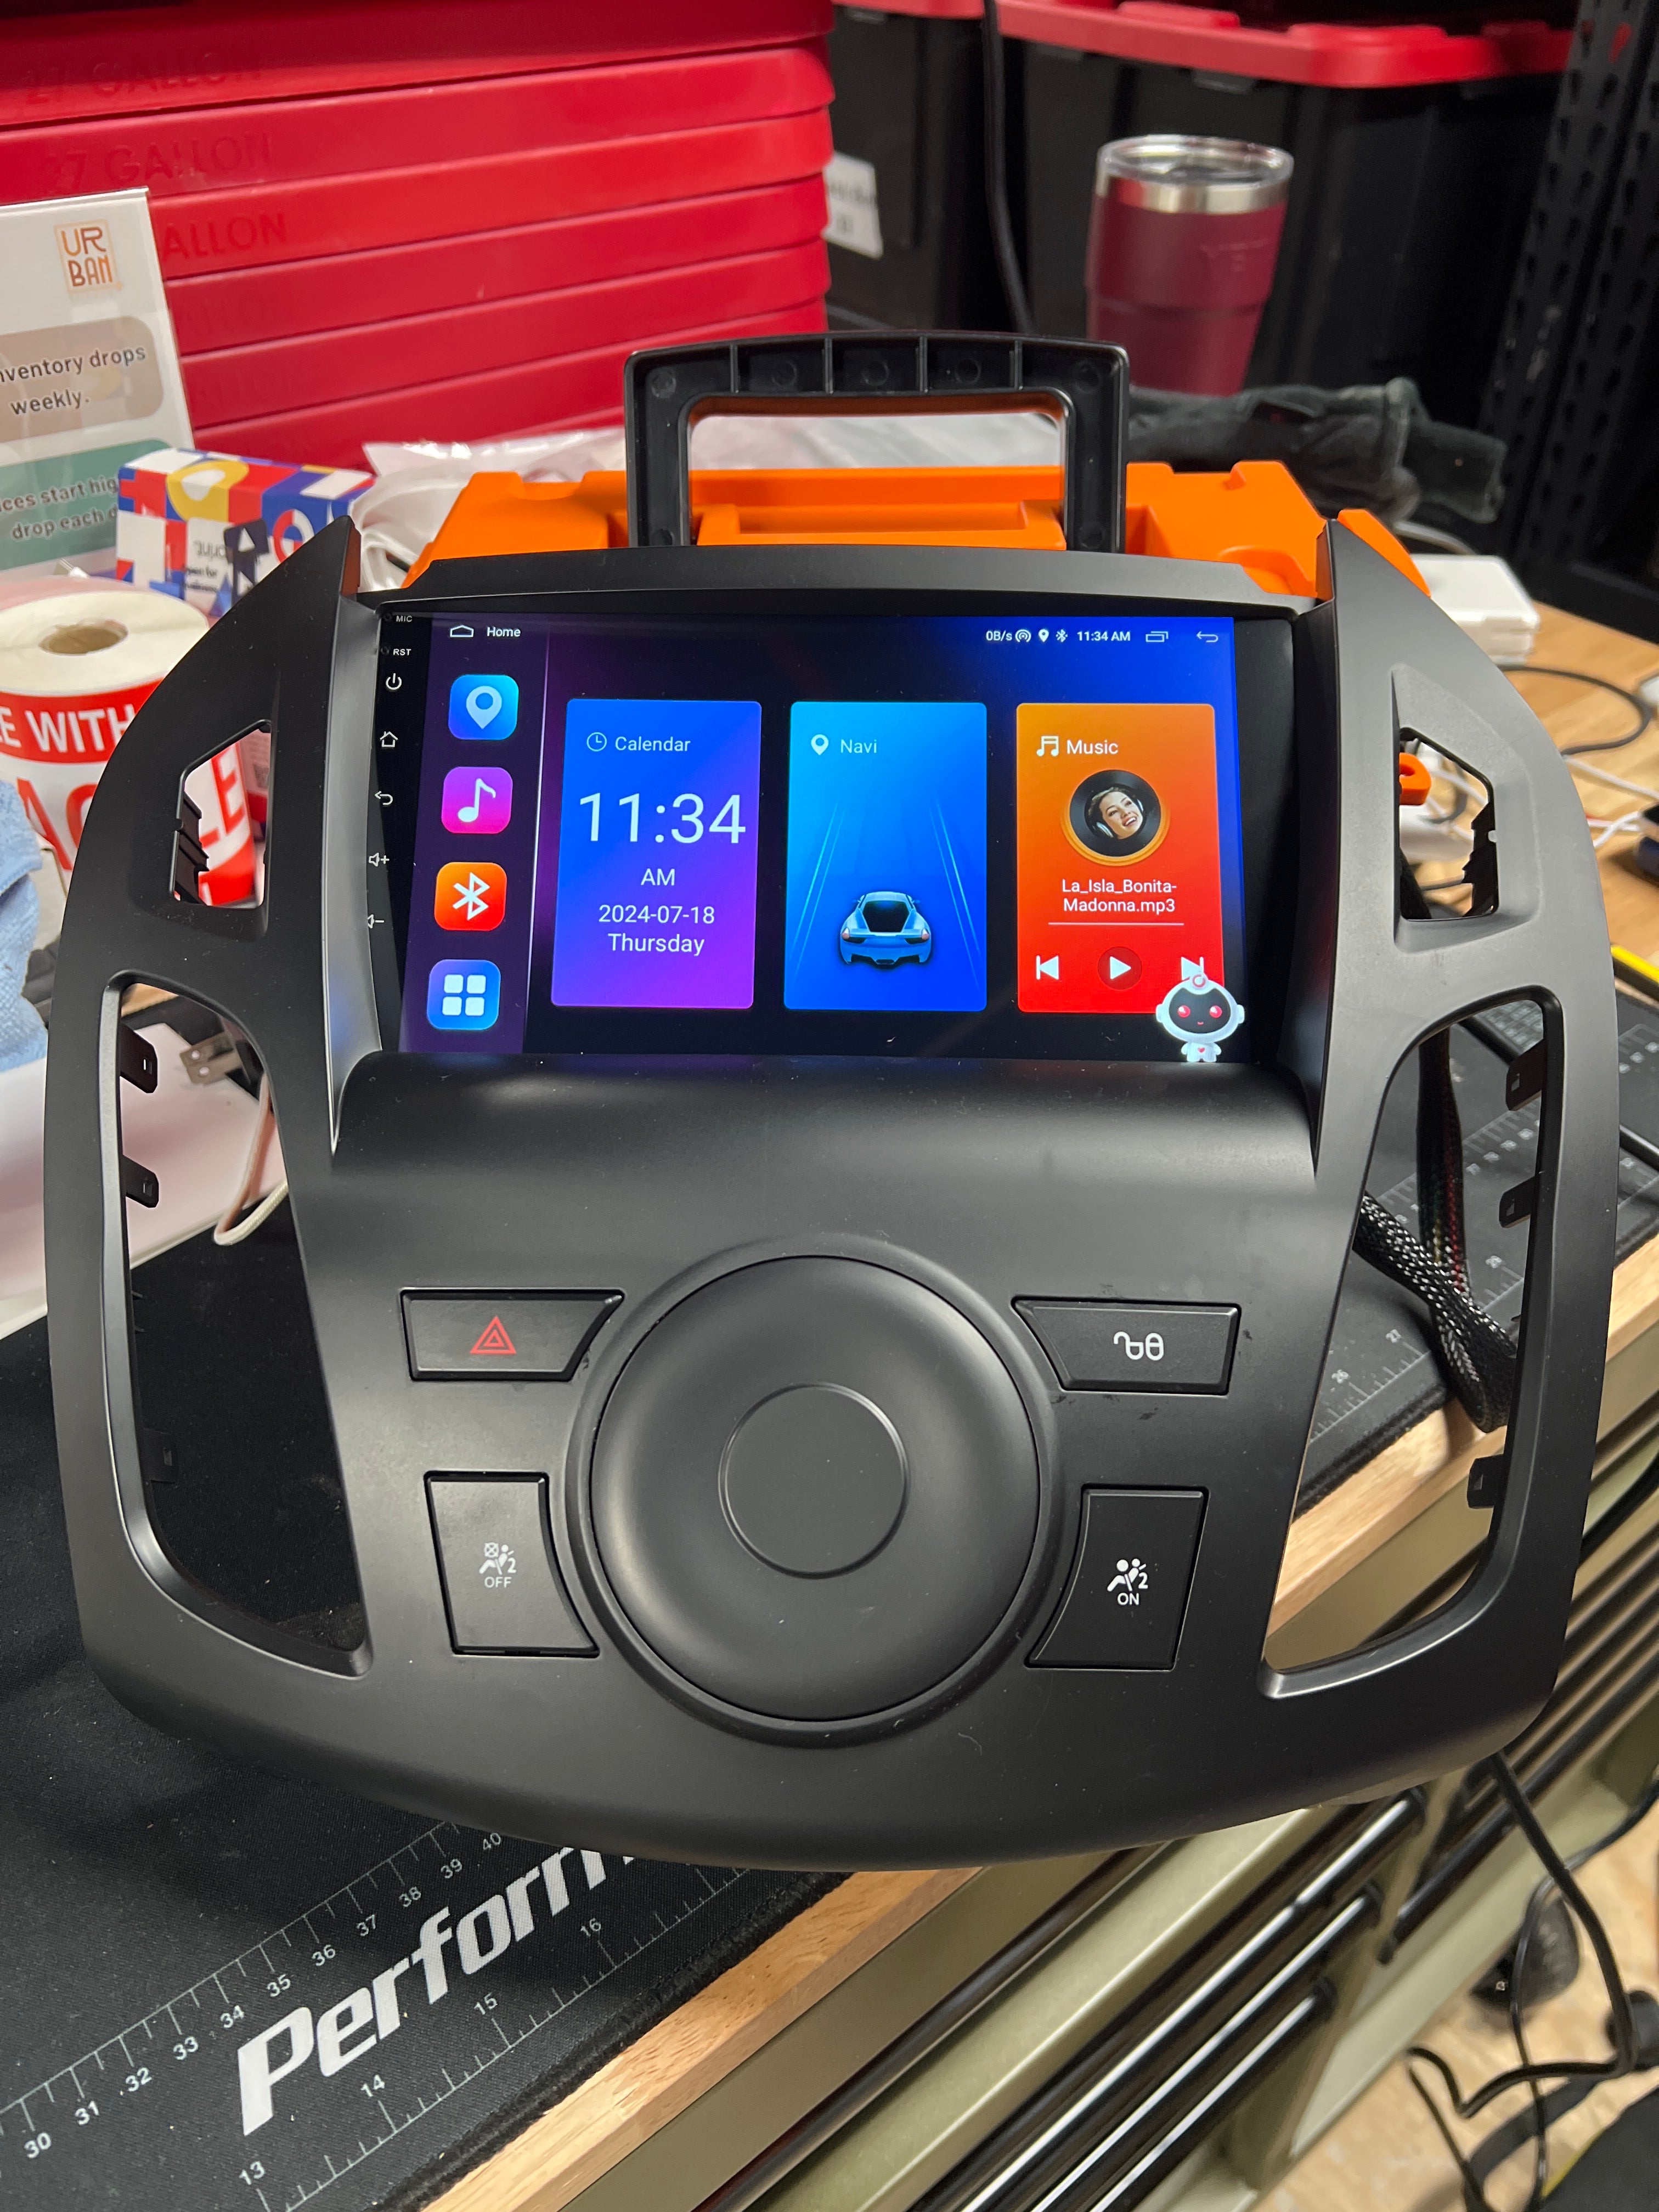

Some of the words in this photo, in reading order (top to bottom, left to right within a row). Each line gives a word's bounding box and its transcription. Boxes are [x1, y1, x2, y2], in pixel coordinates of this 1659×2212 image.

[61, 226, 106, 256] UR
[163, 212, 287, 262] ALLON
[67, 256, 112, 287] BAN
[89, 347, 145, 366] drops
[11, 389, 89, 415] weekly.
[41, 484, 84, 504] start
[13, 521, 55, 539] drop
[60, 508, 104, 529] each
[487, 627, 521, 637] Home
[986, 630, 1013, 641] 0B/s
[1077, 631, 1108, 641] 11:34
[1111, 631, 1131, 641] AM
[393, 648, 411, 656] RST
[615, 736, 691, 752] Calendar
[840, 739, 877, 754] Navi
[1066, 740, 1119, 755] Music
[580, 793, 746, 844] 11:34
[640, 868, 675, 886] AM
[1062, 878, 1177, 894] La_Isla_Bonita-
[599, 904, 715, 924] 2024-07-18
[1063, 898, 1175, 915] Madonna.mp3
[608, 933, 705, 956] Thursday
[484, 1576, 512, 1589] OFF
[1117, 1592, 1139, 1606] ON
[483, 1832, 502, 1850] 40
[441, 1858, 462, 1879] 39
[399, 1886, 421, 1908] 38
[357, 1915, 377, 1937] 37
[580, 1917, 601, 1937] 16
[312, 1944, 336, 1966] 36
[267, 1974, 291, 1997] 35
[473, 1993, 498, 2015] 15
[220, 2005, 244, 2028] 34
[173, 2036, 199, 2060] 33
[125, 2067, 152, 2092] 32
[360, 2074, 385, 2097] 14
[75, 2101, 99, 2125] 31
[24, 2132, 52, 2159] 30
[239, 2162, 266, 2186] 13
